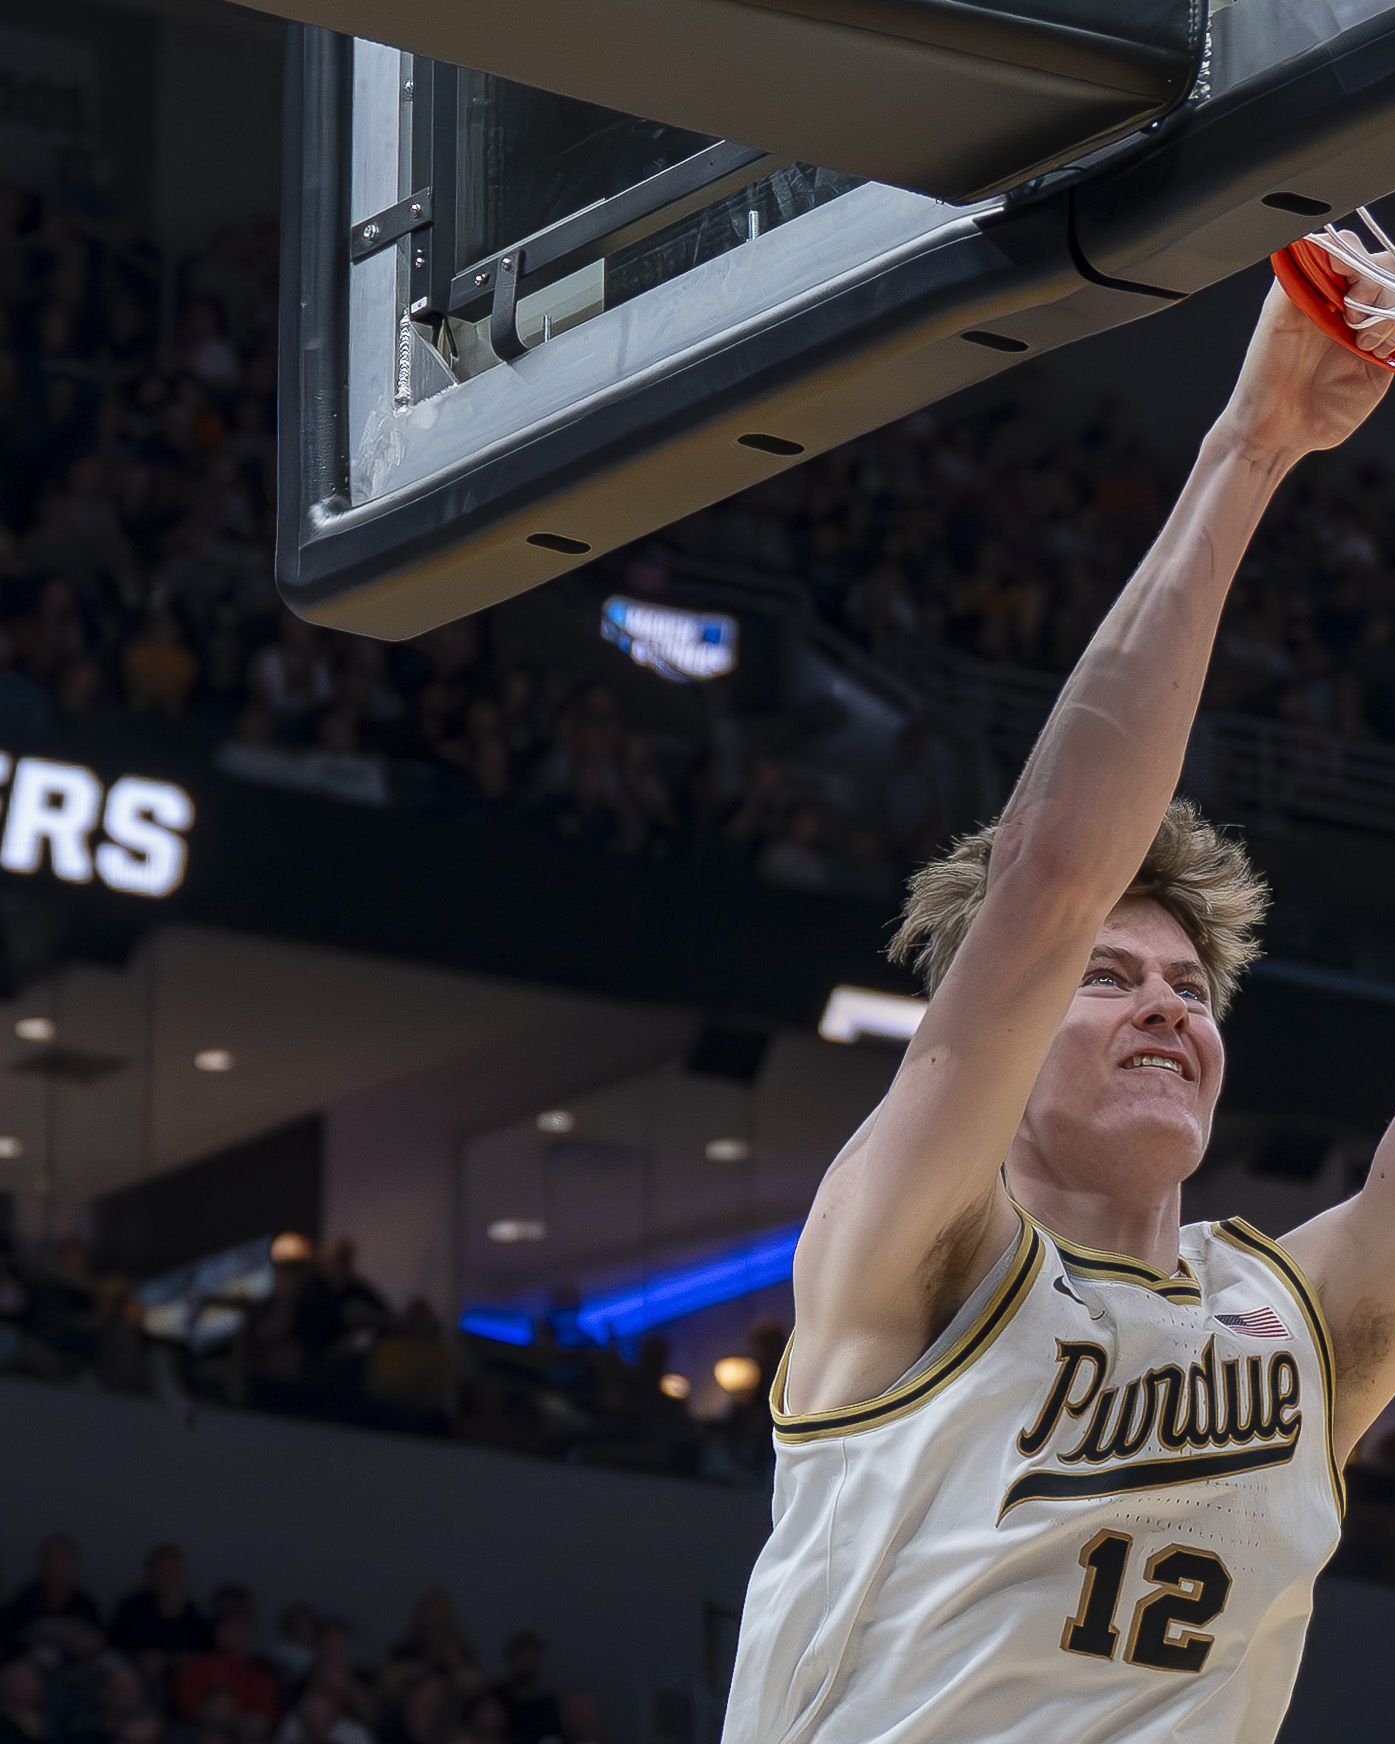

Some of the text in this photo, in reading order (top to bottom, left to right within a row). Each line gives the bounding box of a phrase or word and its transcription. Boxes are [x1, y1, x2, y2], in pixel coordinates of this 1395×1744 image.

[0, 748, 196, 898] RS
[1017, 1334, 1302, 1464] Purdue
[1059, 1527, 1233, 1674] 12
